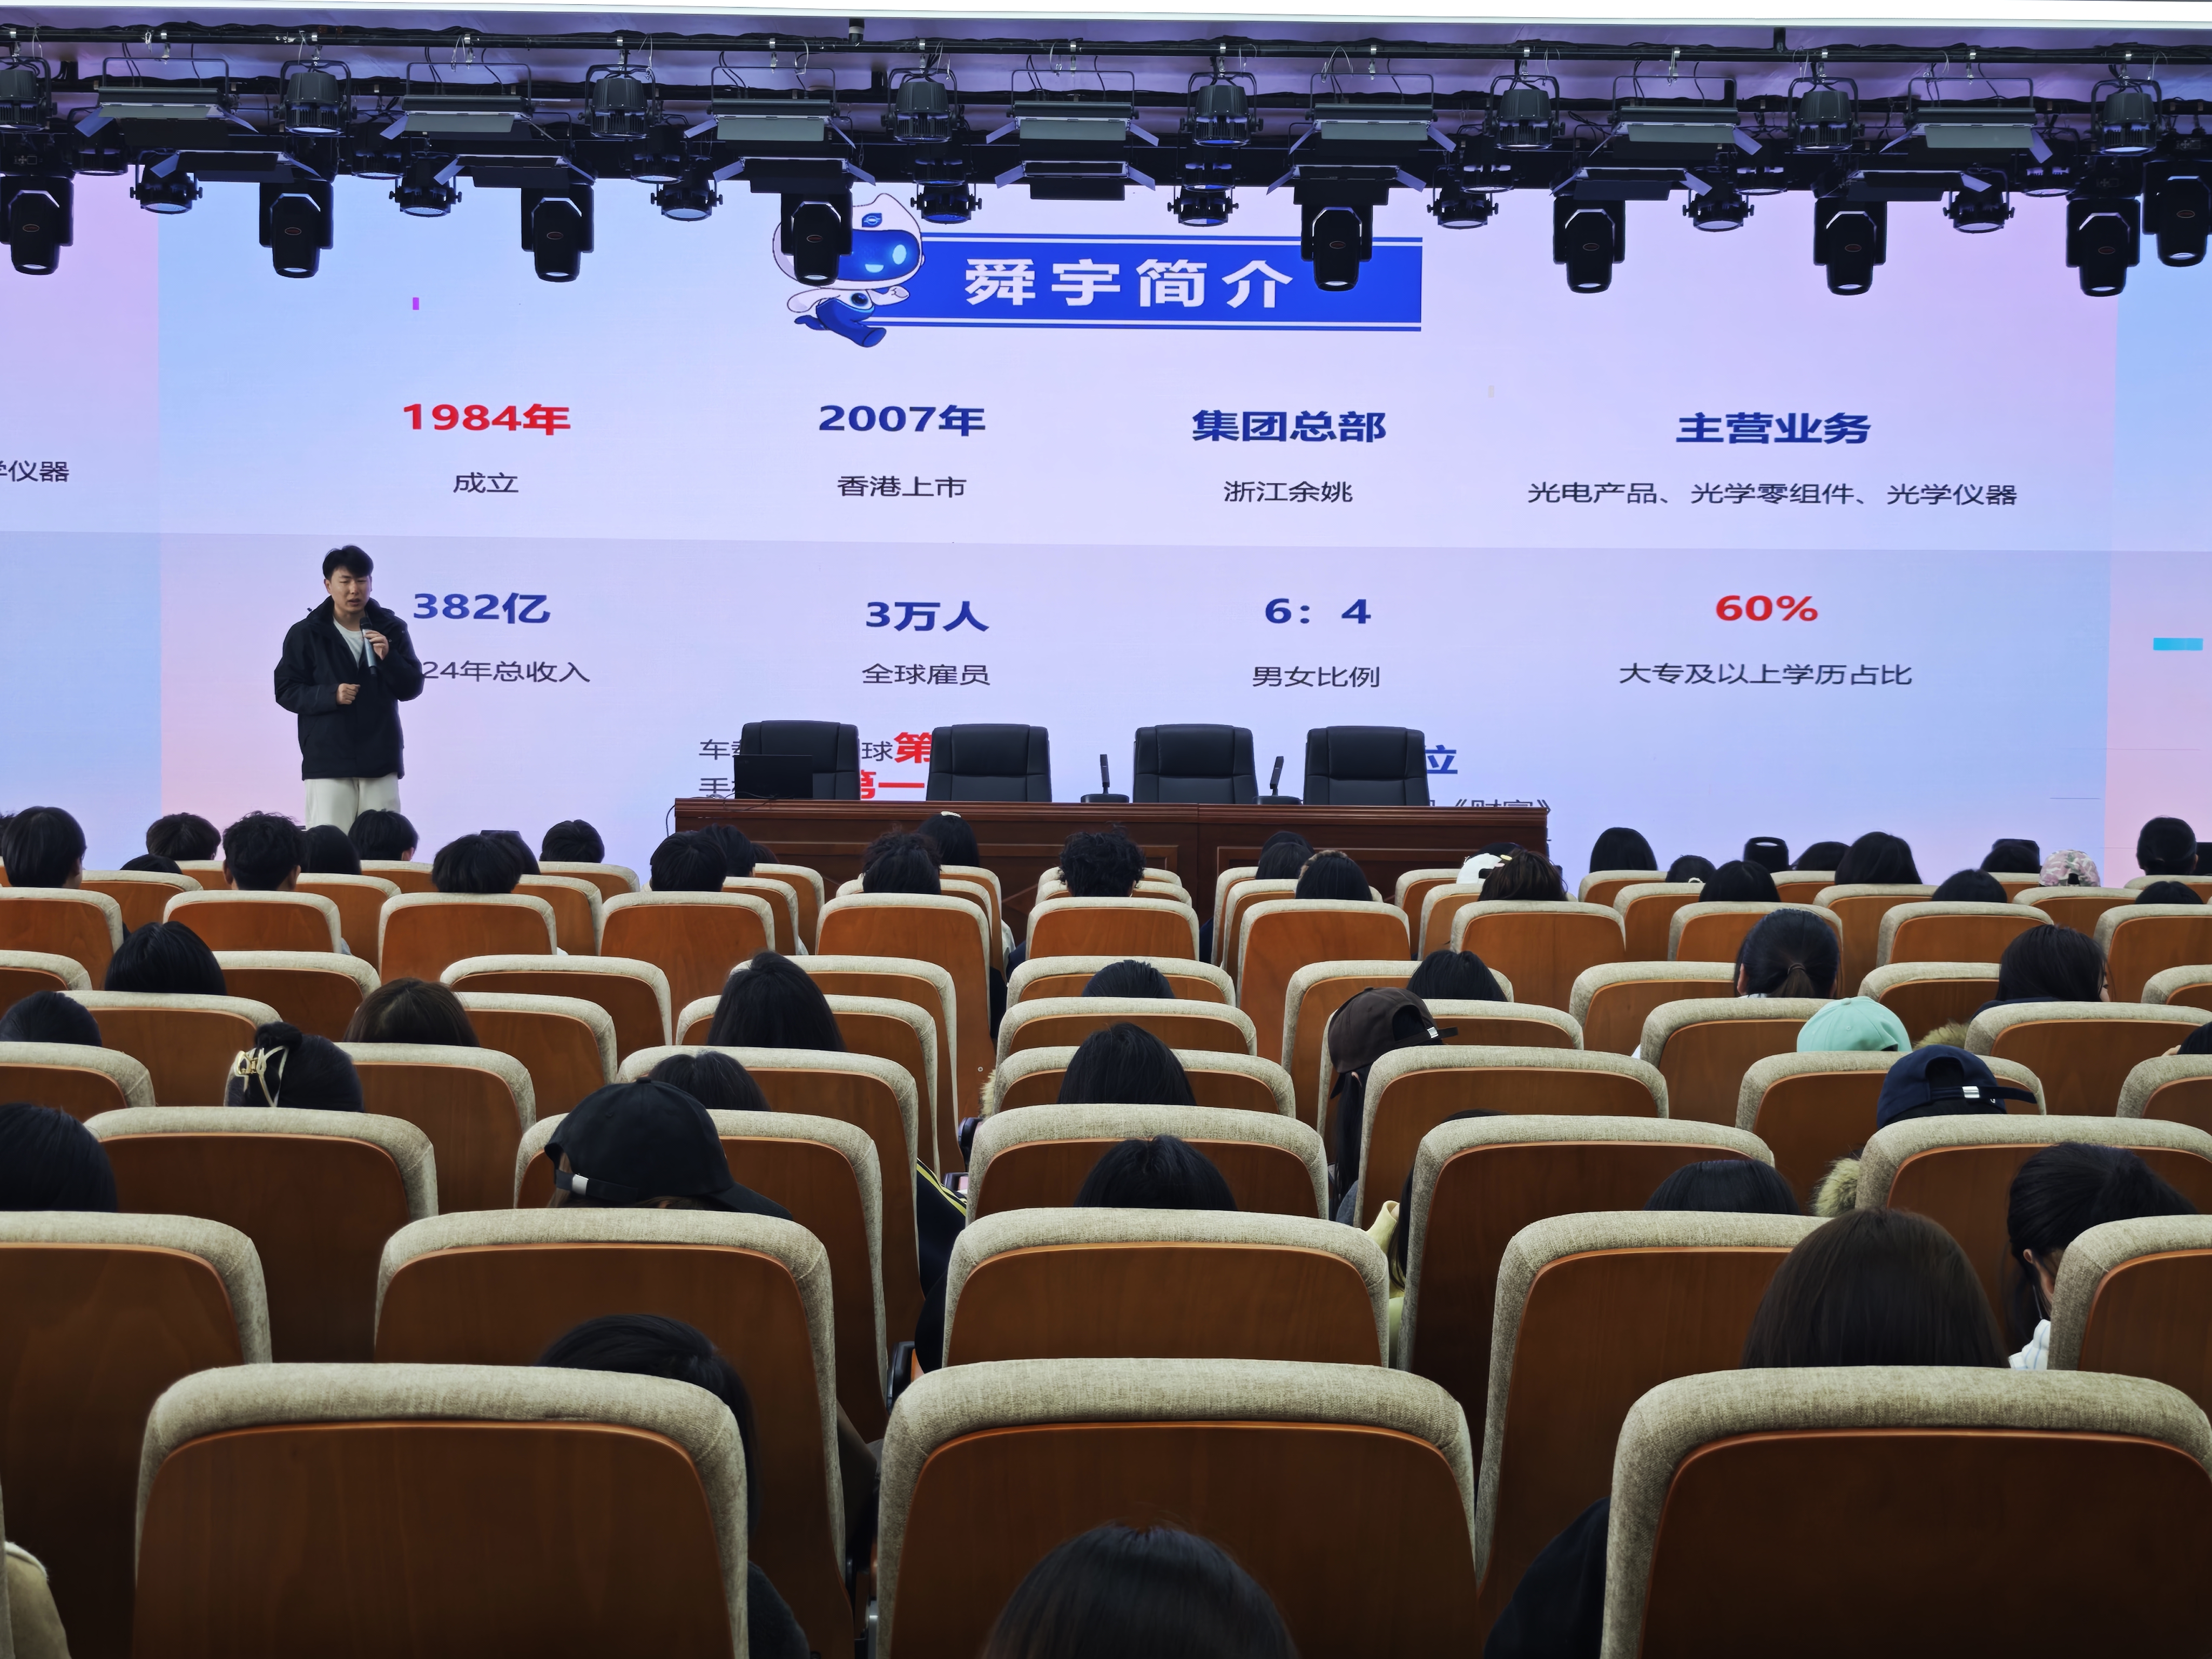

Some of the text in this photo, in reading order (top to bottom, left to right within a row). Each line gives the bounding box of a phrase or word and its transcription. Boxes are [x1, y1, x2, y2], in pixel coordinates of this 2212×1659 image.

[966, 259, 1293, 309] 舜宇简介
[404, 403, 571, 436] 1984年
[819, 404, 987, 437] 2007年
[1192, 410, 1387, 443] 集团总部
[1676, 412, 1872, 445] 主营业务
[0, 461, 70, 482] 仪器
[454, 472, 520, 494] 成立
[838, 476, 968, 499] 香港上市
[1224, 481, 1354, 503] 浙江余姚
[413, 592, 551, 624] 382亿
[866, 601, 990, 632] 3万人
[1716, 595, 1819, 622] 60%
[862, 663, 991, 686] 全球雇员
[1253, 666, 1380, 689] 男女比例
[1620, 663, 1913, 686] 大专及以上学历占比
[699, 778, 735, 794] 手
